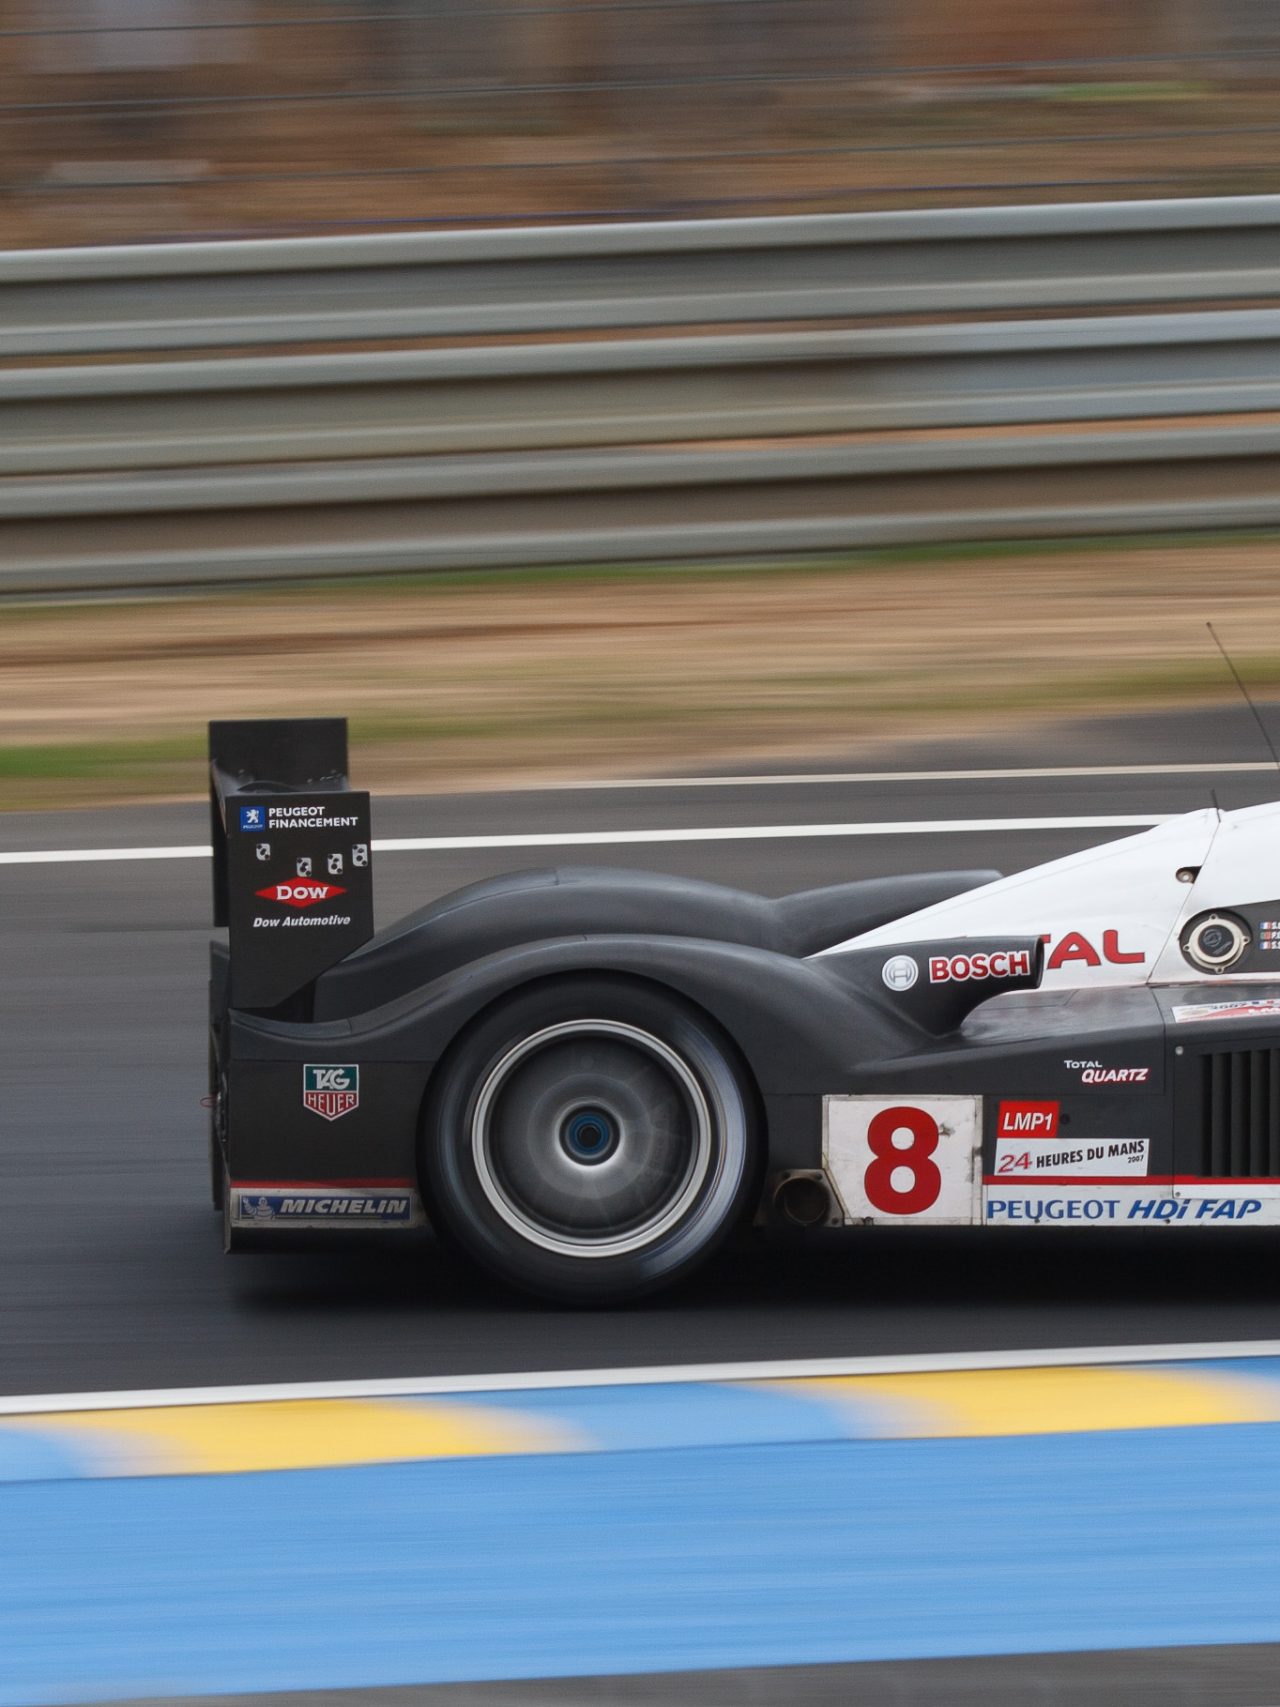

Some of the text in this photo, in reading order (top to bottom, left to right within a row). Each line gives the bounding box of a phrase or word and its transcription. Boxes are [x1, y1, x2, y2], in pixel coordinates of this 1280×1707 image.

[268, 806, 325, 817] PEUGEOT
[268, 816, 359, 829] FINANCEMENT
[276, 885, 329, 900] DOW
[253, 914, 351, 928] Dow Automotive
[1040, 929, 1145, 970] AL
[930, 952, 1030, 982] BOSCH
[1064, 1060, 1103, 1069] TOTAL
[312, 1068, 350, 1090] TAG
[1081, 1068, 1149, 1084] QUARTZ
[307, 1093, 355, 1117] HEUER
[1003, 1112, 1053, 1131] LMP1
[863, 1106, 942, 1215] 8
[998, 1140, 1145, 1174] 24 HEURES DU MANS
[1128, 1155, 1144, 1164] 2007
[280, 1199, 407, 1214] MICHELIN
[987, 1199, 1262, 1220] PEUGEOT HDi FAP
